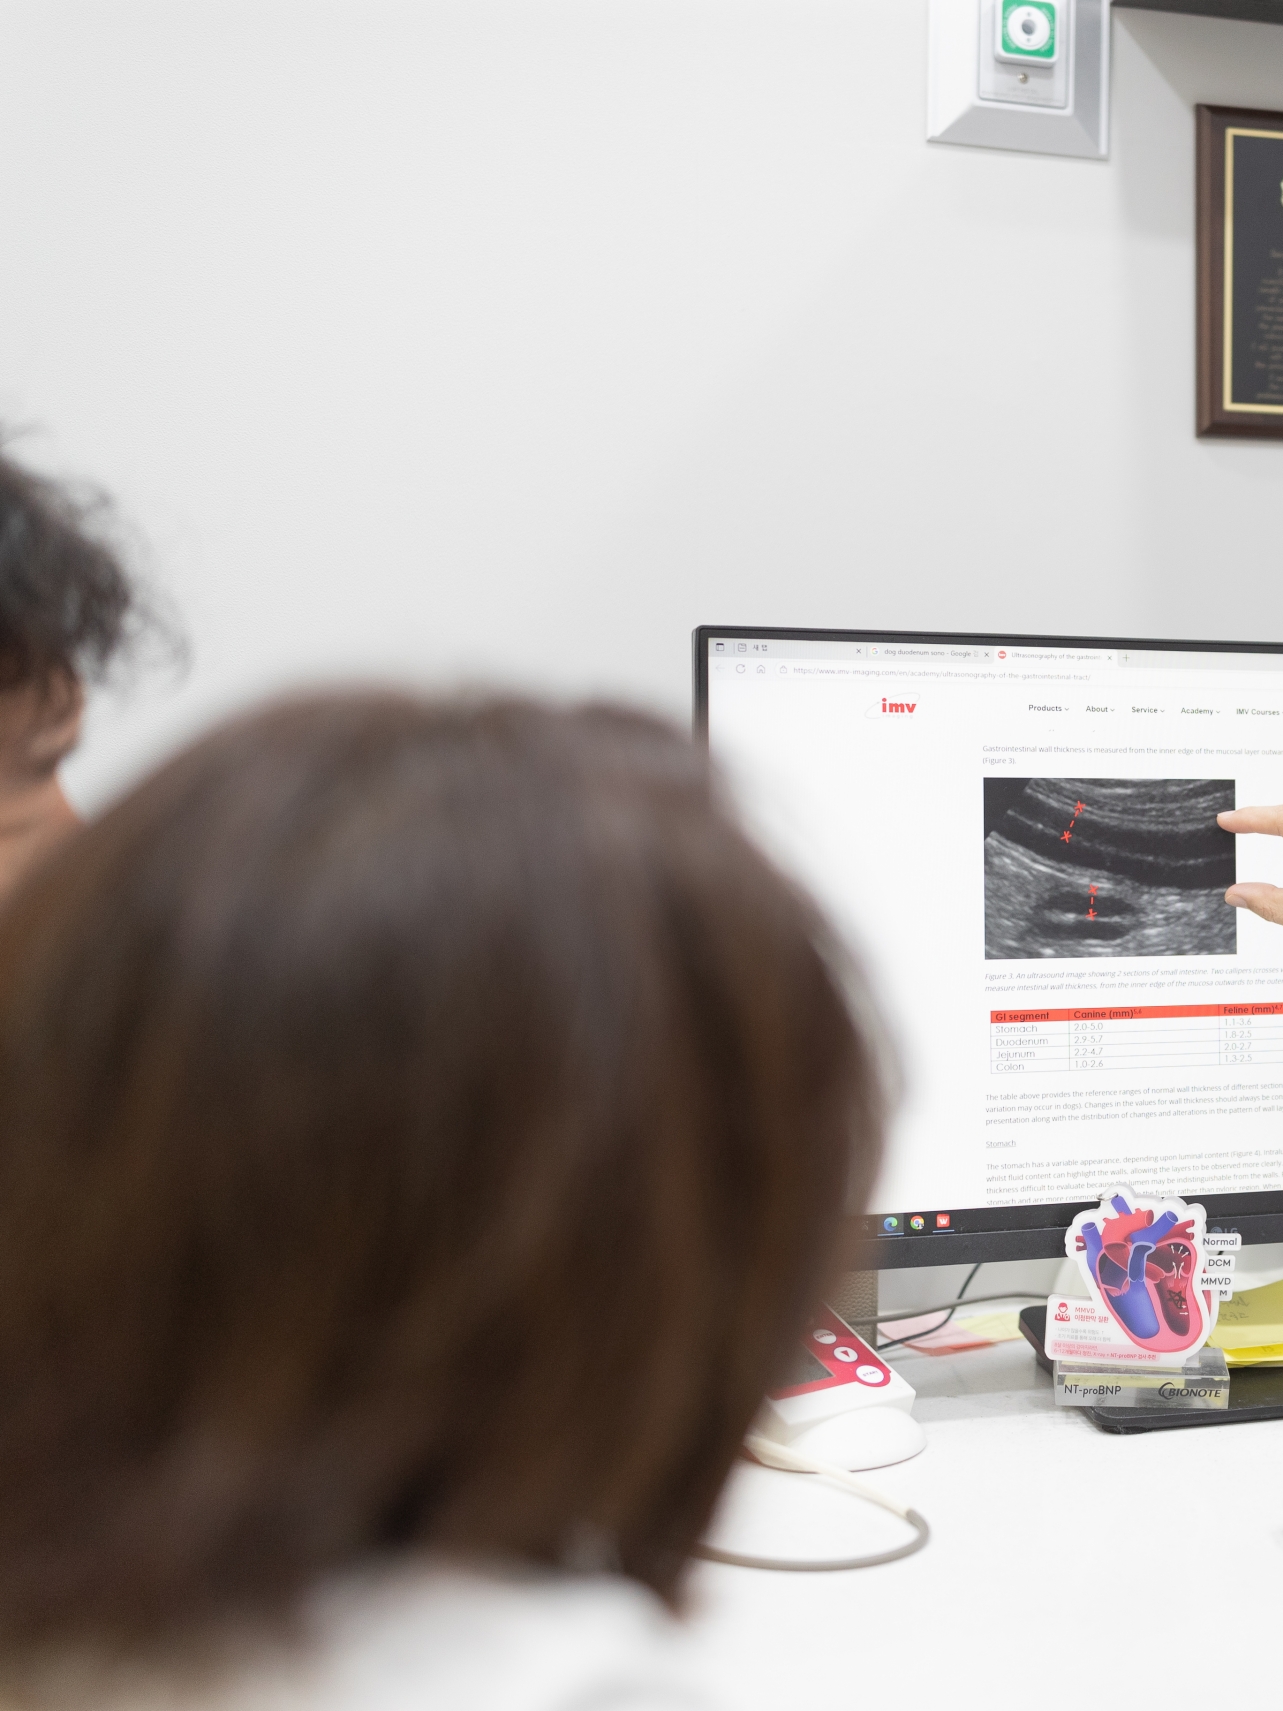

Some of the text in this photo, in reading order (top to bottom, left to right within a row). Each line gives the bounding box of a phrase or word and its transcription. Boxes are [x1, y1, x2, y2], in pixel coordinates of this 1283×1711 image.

[950, 650, 972, 658] Google
[1011, 652, 1057, 660] Ultrasonography
[881, 698, 917, 714] imv
[1028, 704, 1062, 713] Products
[1086, 705, 1108, 713] About
[1131, 706, 1158, 714] Service
[1180, 707, 1214, 716] Academy
[1177, 747, 1194, 756] edge
[1244, 748, 1259, 757] layer
[982, 757, 1006, 766] (Figure
[995, 1012, 1007, 1021] GI
[1009, 1011, 1050, 1022] segment
[1073, 1010, 1107, 1019] Canine
[1223, 1005, 1249, 1014] Feline
[995, 1018, 1252, 1034] Stomach 2.0-5.0 1.1-3.6
[996, 1030, 1252, 1046] Duodenum 2.9-5.7 1.8-2.5
[996, 1042, 1252, 1061] Jejunum 2.2-4.7 2.0-2.7
[996, 1054, 1252, 1072] Colon 1.0-2.6 1.3-2.5
[1041, 1091, 1070, 1100] provides
[1222, 1083, 1229, 1092] of
[986, 1139, 1016, 1148] Stomach
[1122, 1155, 1158, 1164] depending
[1159, 1154, 1177, 1163] upon
[1178, 1152, 1203, 1161] luminal
[1230, 1150, 1252, 1159] (Figure
[1064, 1384, 1221, 1398] NT-proBNP BIONOTE
